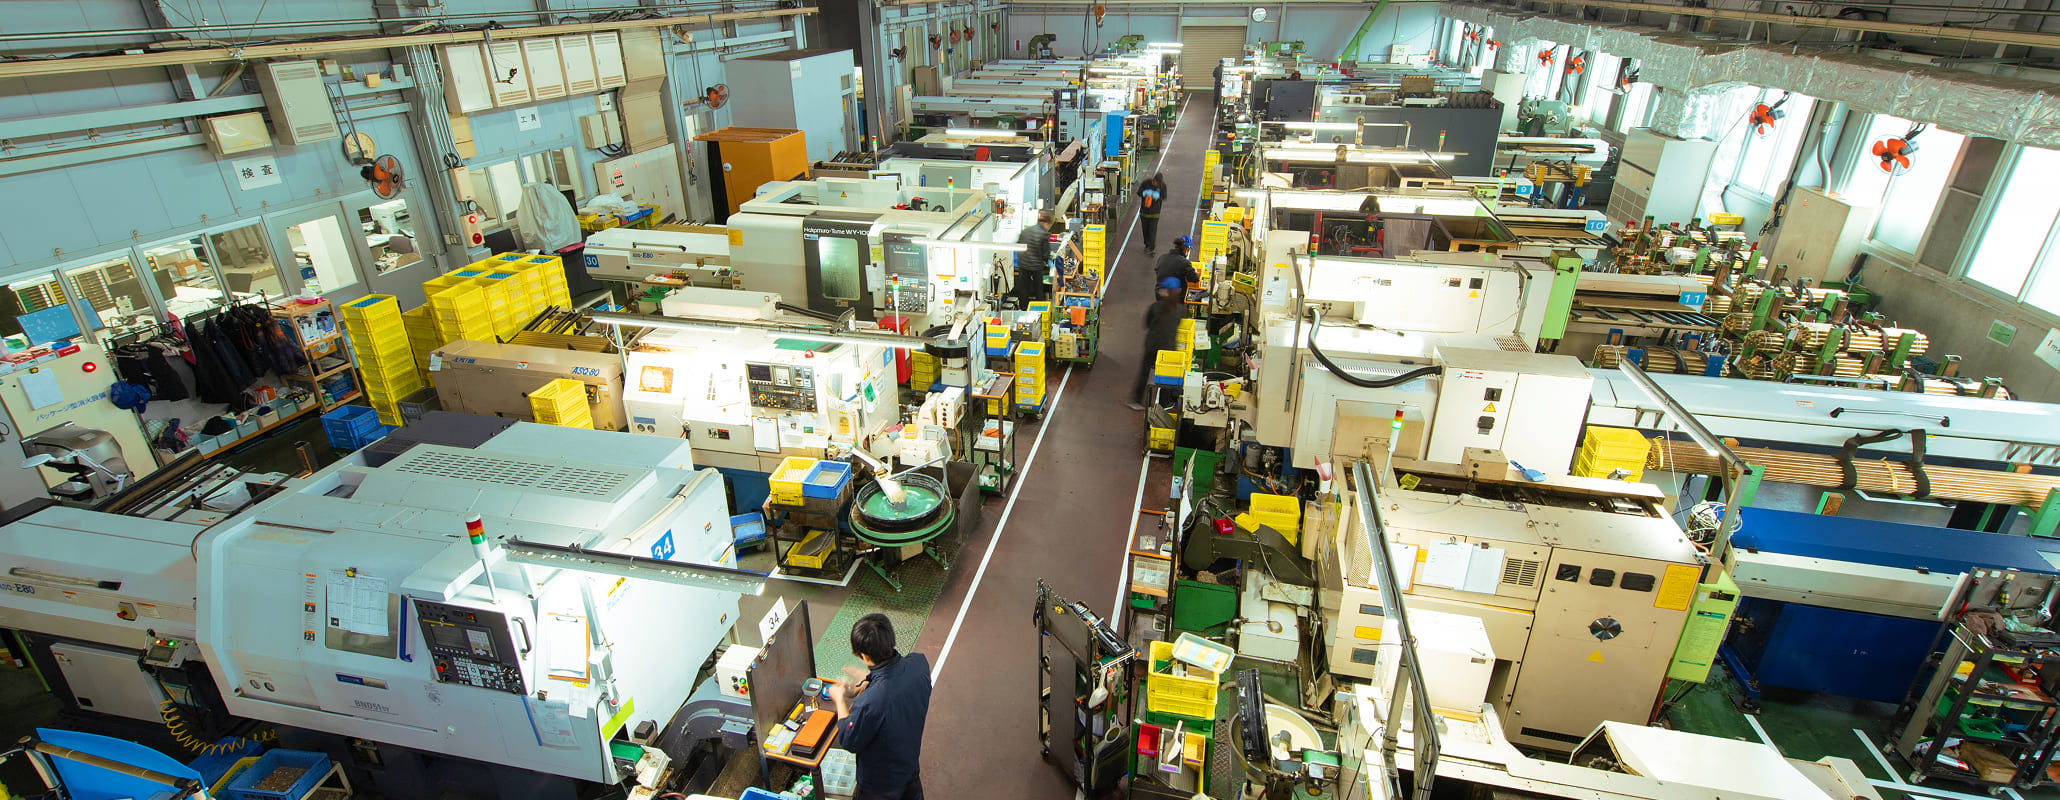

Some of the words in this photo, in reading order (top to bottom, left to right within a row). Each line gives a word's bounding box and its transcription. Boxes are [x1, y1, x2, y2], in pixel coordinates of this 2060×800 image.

[241, 164, 273, 179] 検査
[1590, 221, 1604, 230] 10
[586, 256, 598, 266] 30
[1685, 294, 1701, 304] 11
[654, 536, 672, 560] 34
[769, 611, 779, 630] 34
